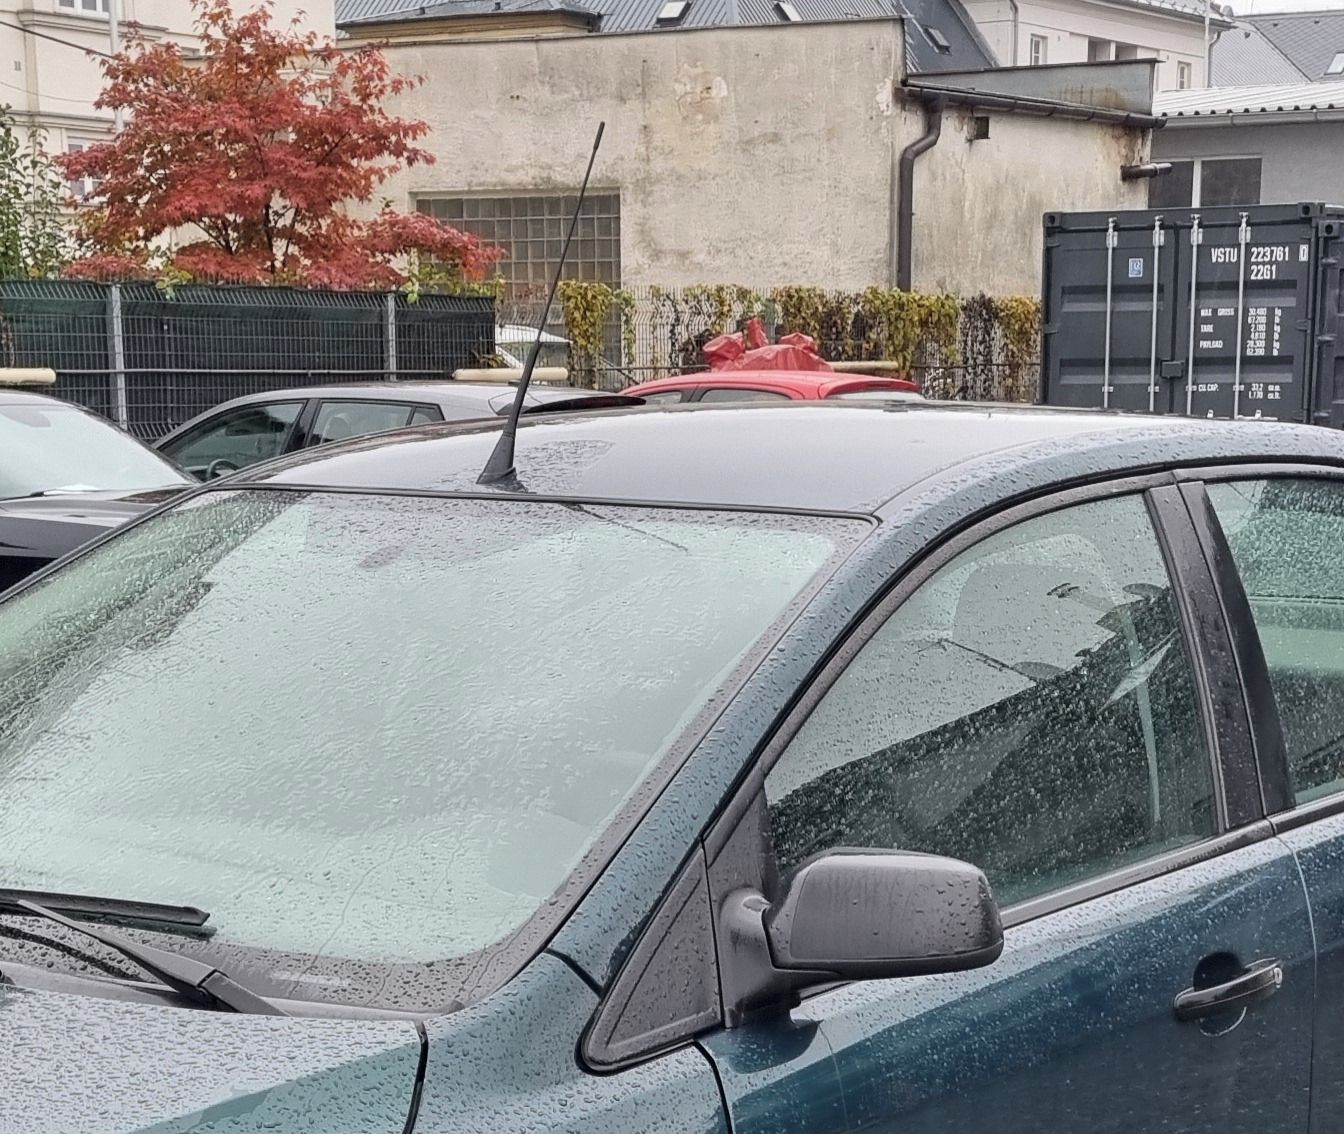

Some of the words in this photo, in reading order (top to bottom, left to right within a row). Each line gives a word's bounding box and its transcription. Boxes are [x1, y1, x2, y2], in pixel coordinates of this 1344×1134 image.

[1211, 248, 1238, 263] VSTU
[1251, 246, 1289, 262] 223761
[1251, 264, 1276, 279] 22G1
[1200, 340, 1223, 348] PAYLOAD
